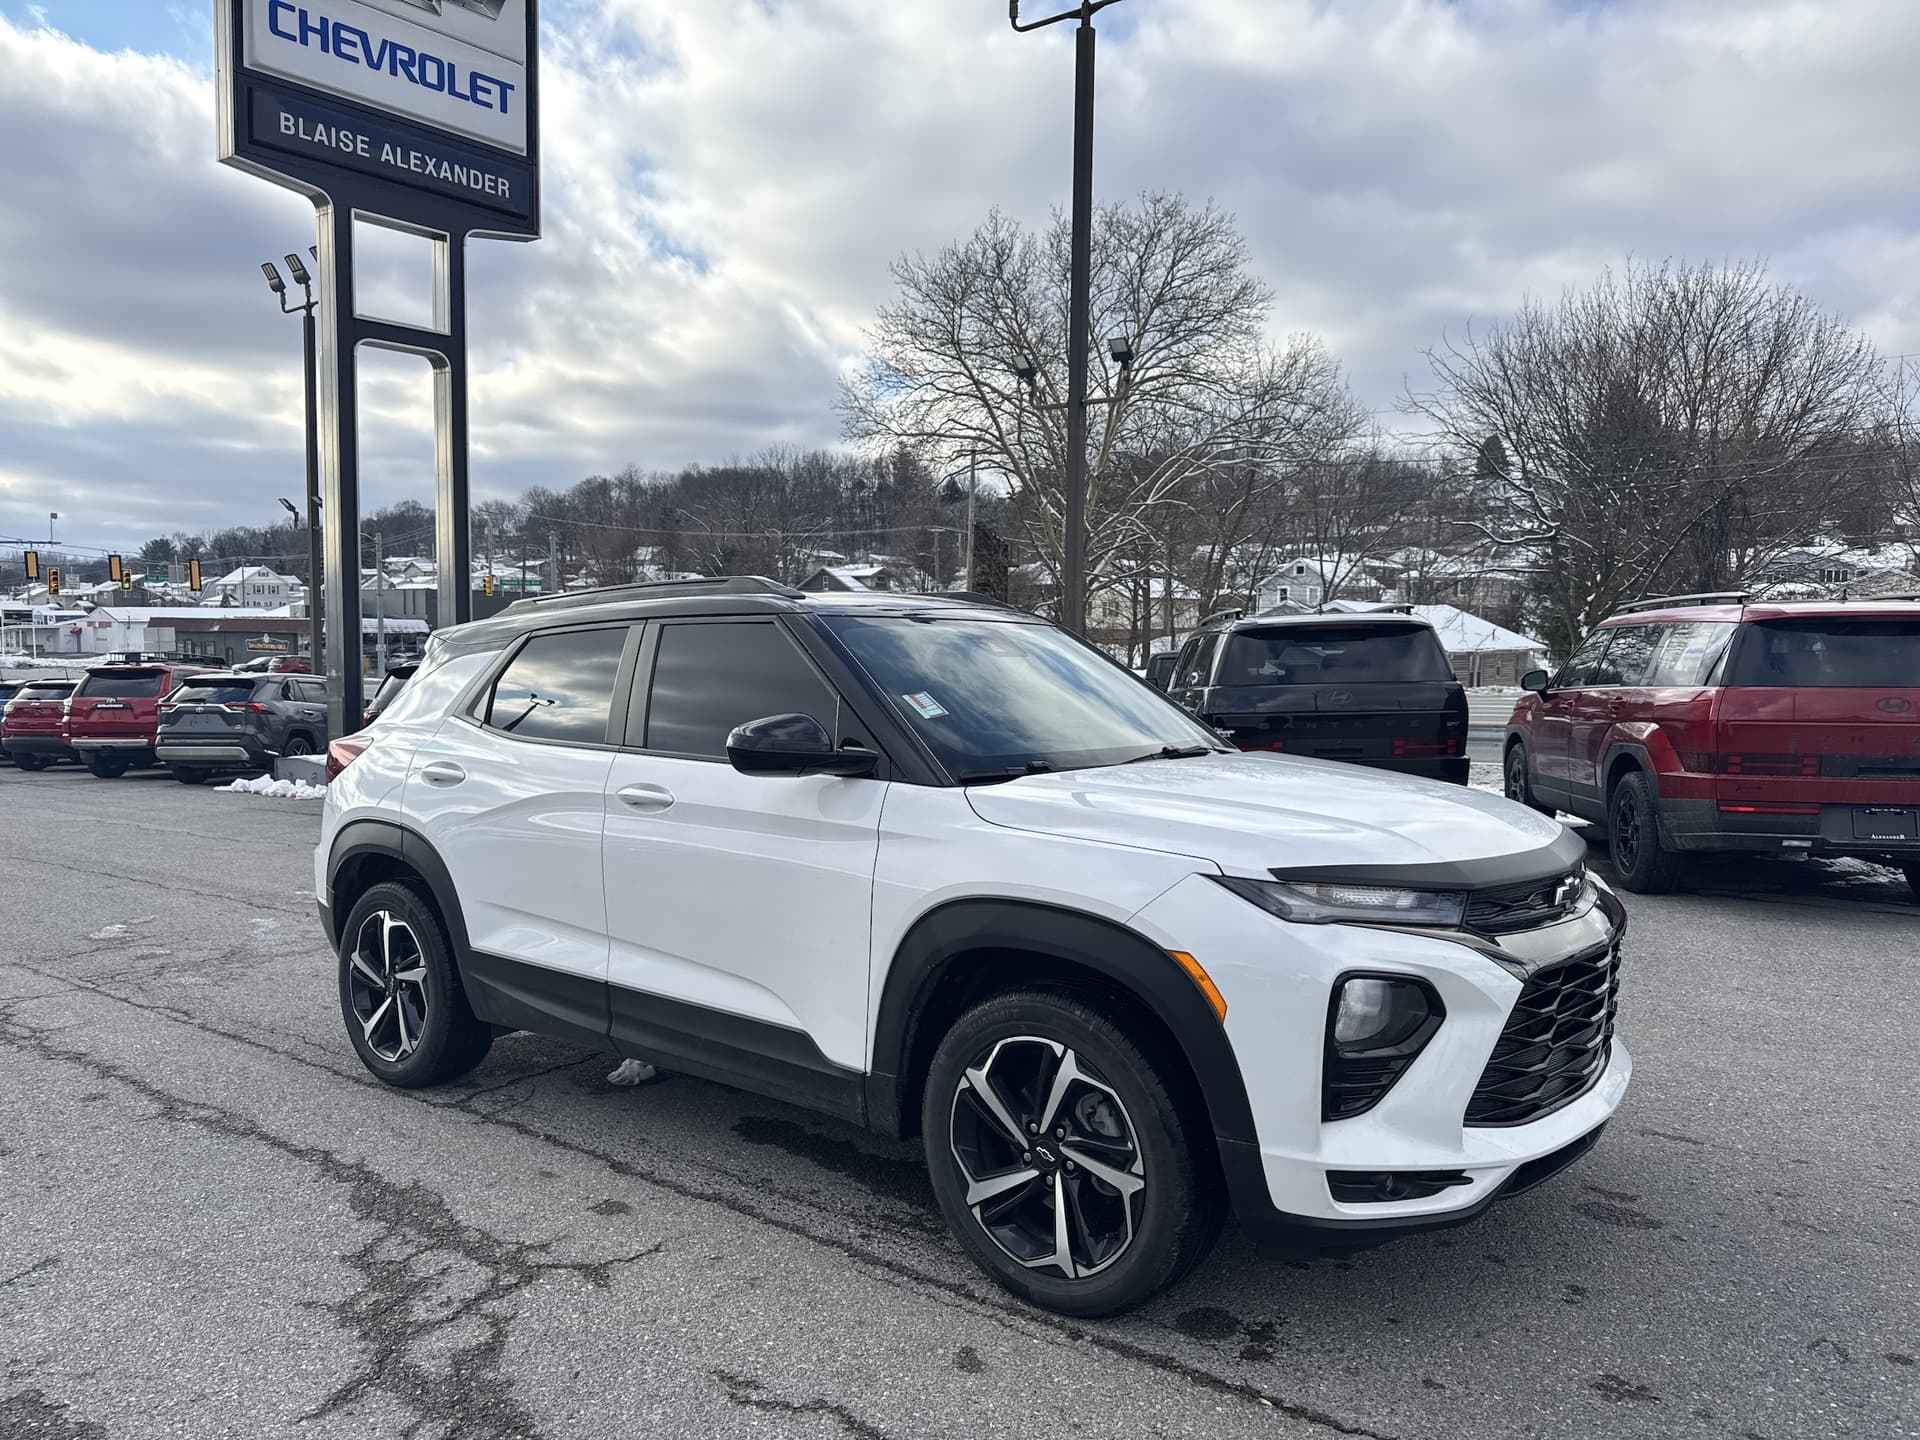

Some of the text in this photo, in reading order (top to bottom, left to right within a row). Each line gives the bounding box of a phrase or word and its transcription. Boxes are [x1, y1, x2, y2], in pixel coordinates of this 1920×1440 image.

[268, 0, 515, 115] CHEVROLET
[279, 111, 511, 199] BLAISE ALEXANDER
